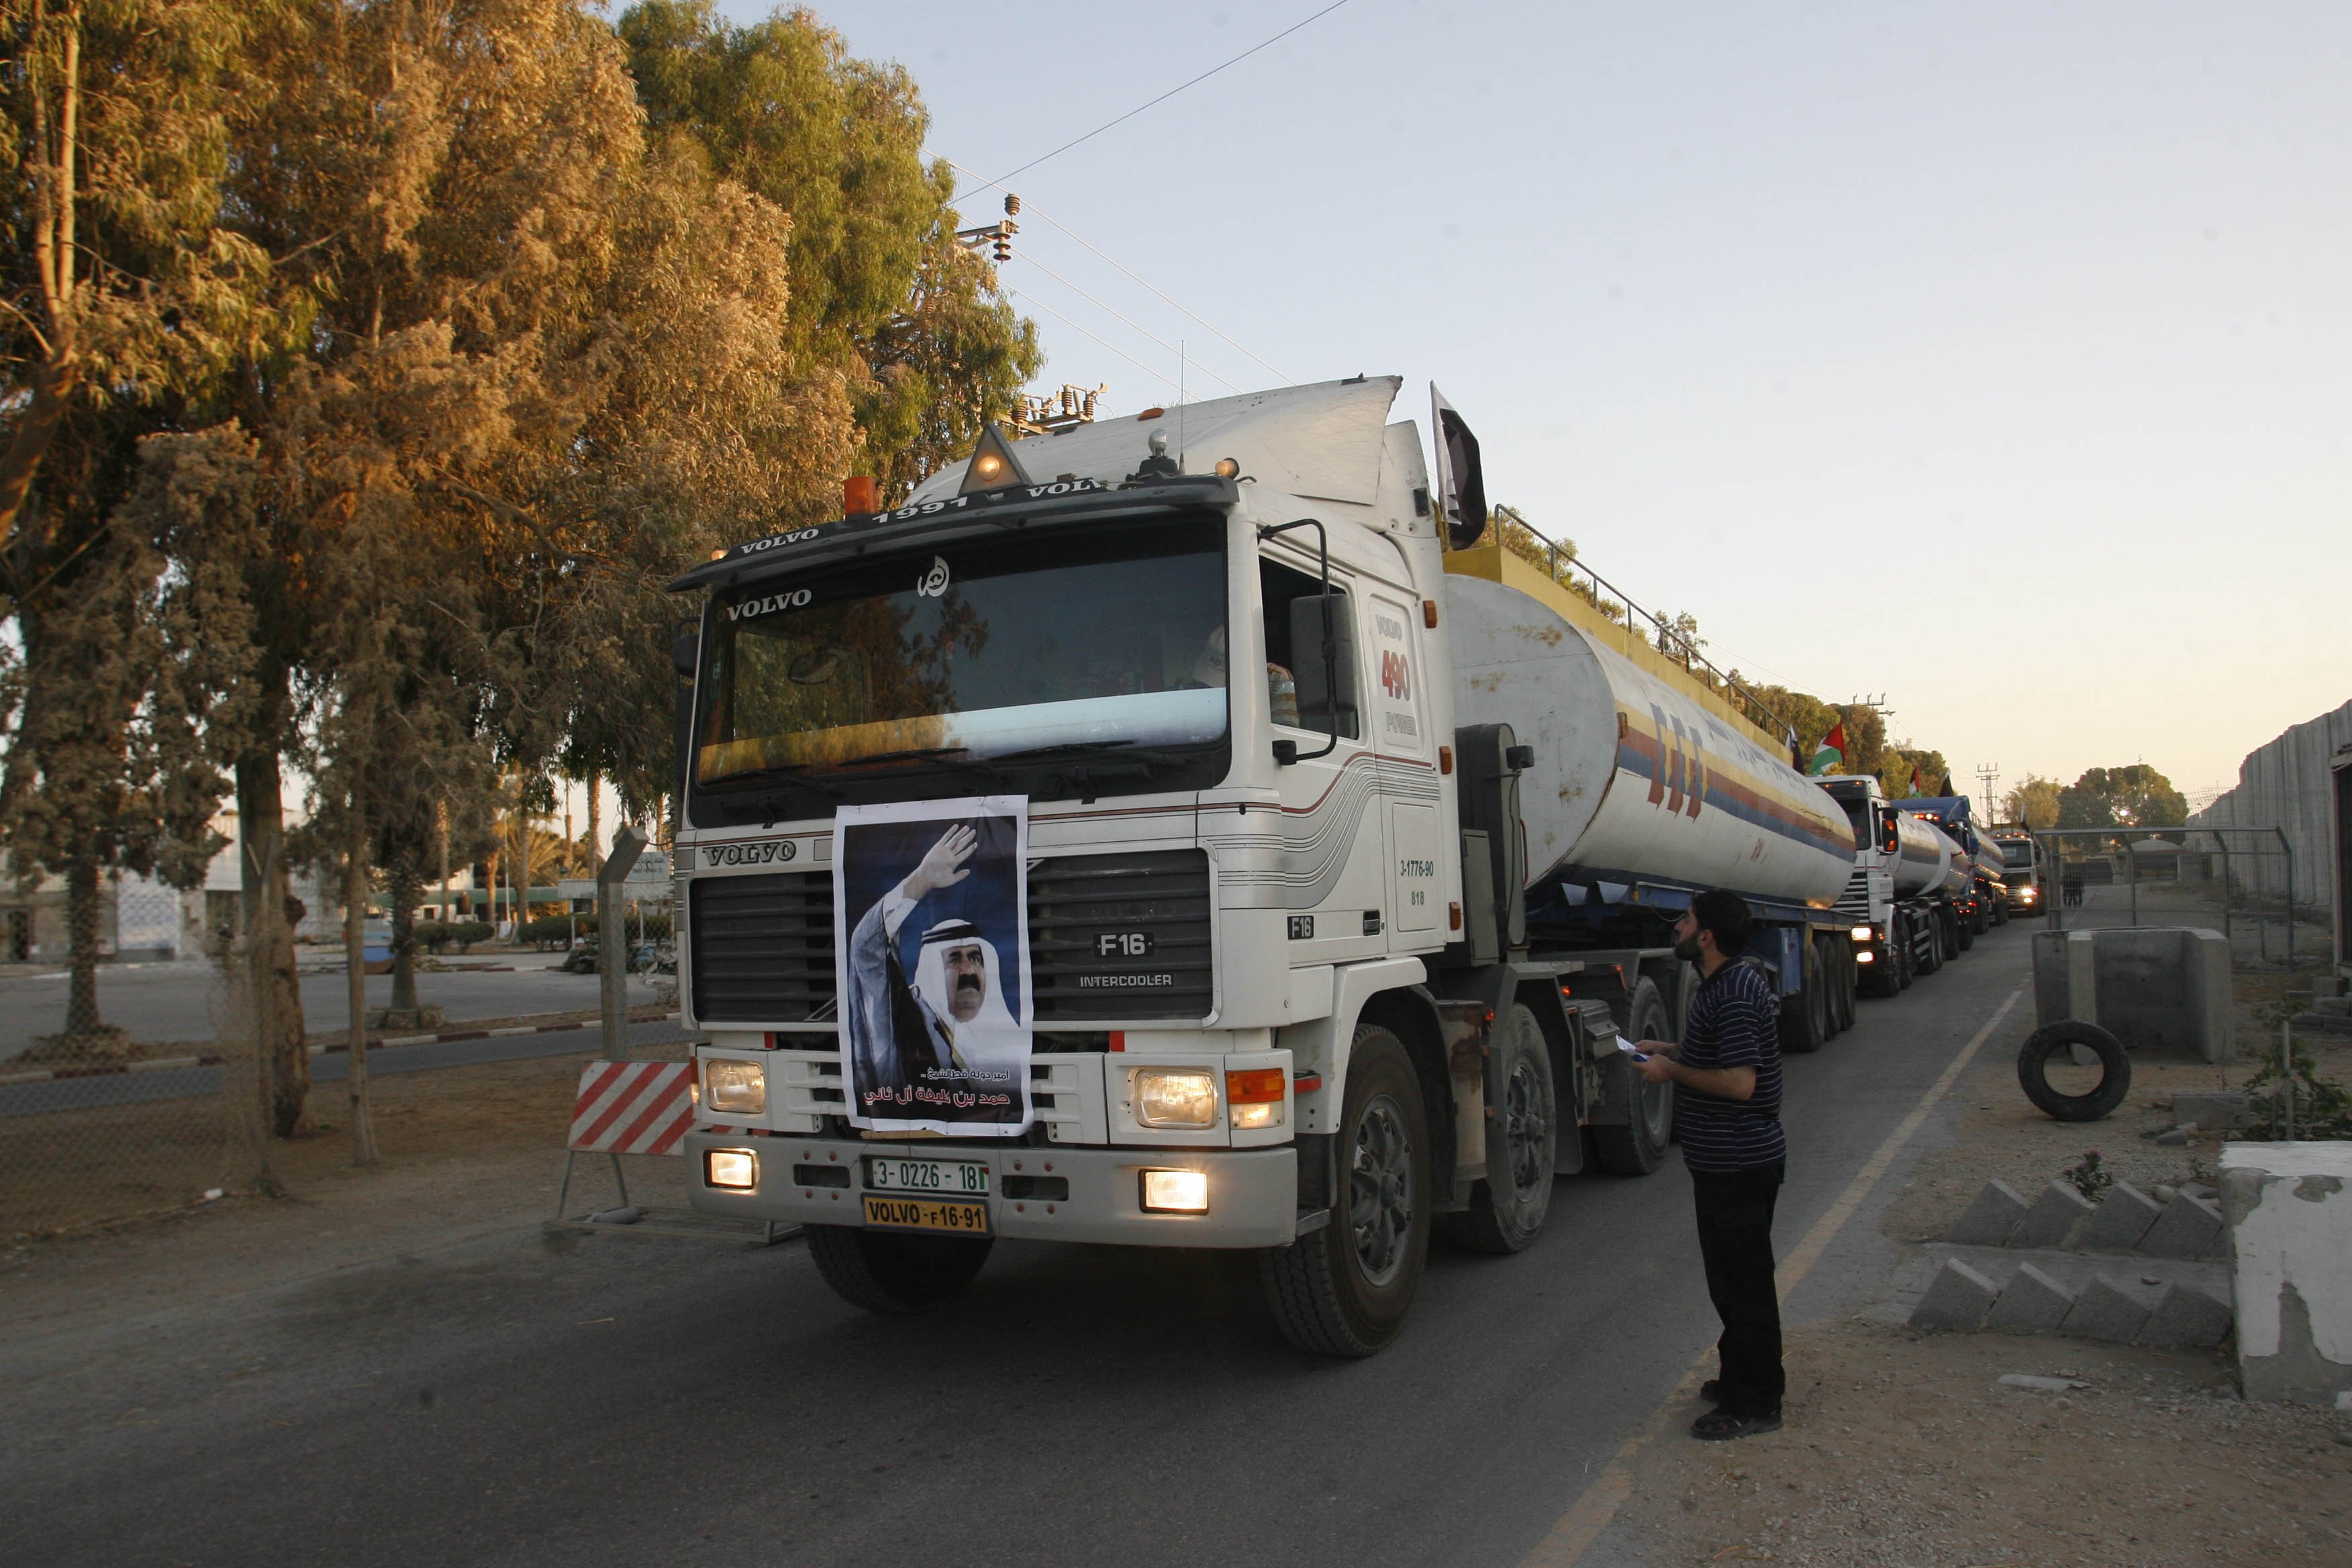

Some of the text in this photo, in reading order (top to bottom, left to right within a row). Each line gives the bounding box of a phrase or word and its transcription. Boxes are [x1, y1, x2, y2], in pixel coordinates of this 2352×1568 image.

[873, 496, 969, 524] 1991
[740, 528, 820, 554] VOLVO
[726, 589, 812, 622] VOLVO
[1375, 614, 1403, 641] VOLVO
[1381, 649, 1411, 701] 490
[1385, 711, 1418, 736] POWER
[702, 840, 797, 867] VOLVO
[1400, 859, 1434, 877] 3-1776-90
[1411, 891, 1424, 905] 818
[1291, 916, 1312, 938] F16
[1100, 933, 1146, 956] F16
[1079, 974, 1173, 988] INTERCOOLER
[863, 1085, 893, 1106] ثاني
[952, 1090, 976, 1108] بن
[979, 1093, 1010, 1106] حمد
